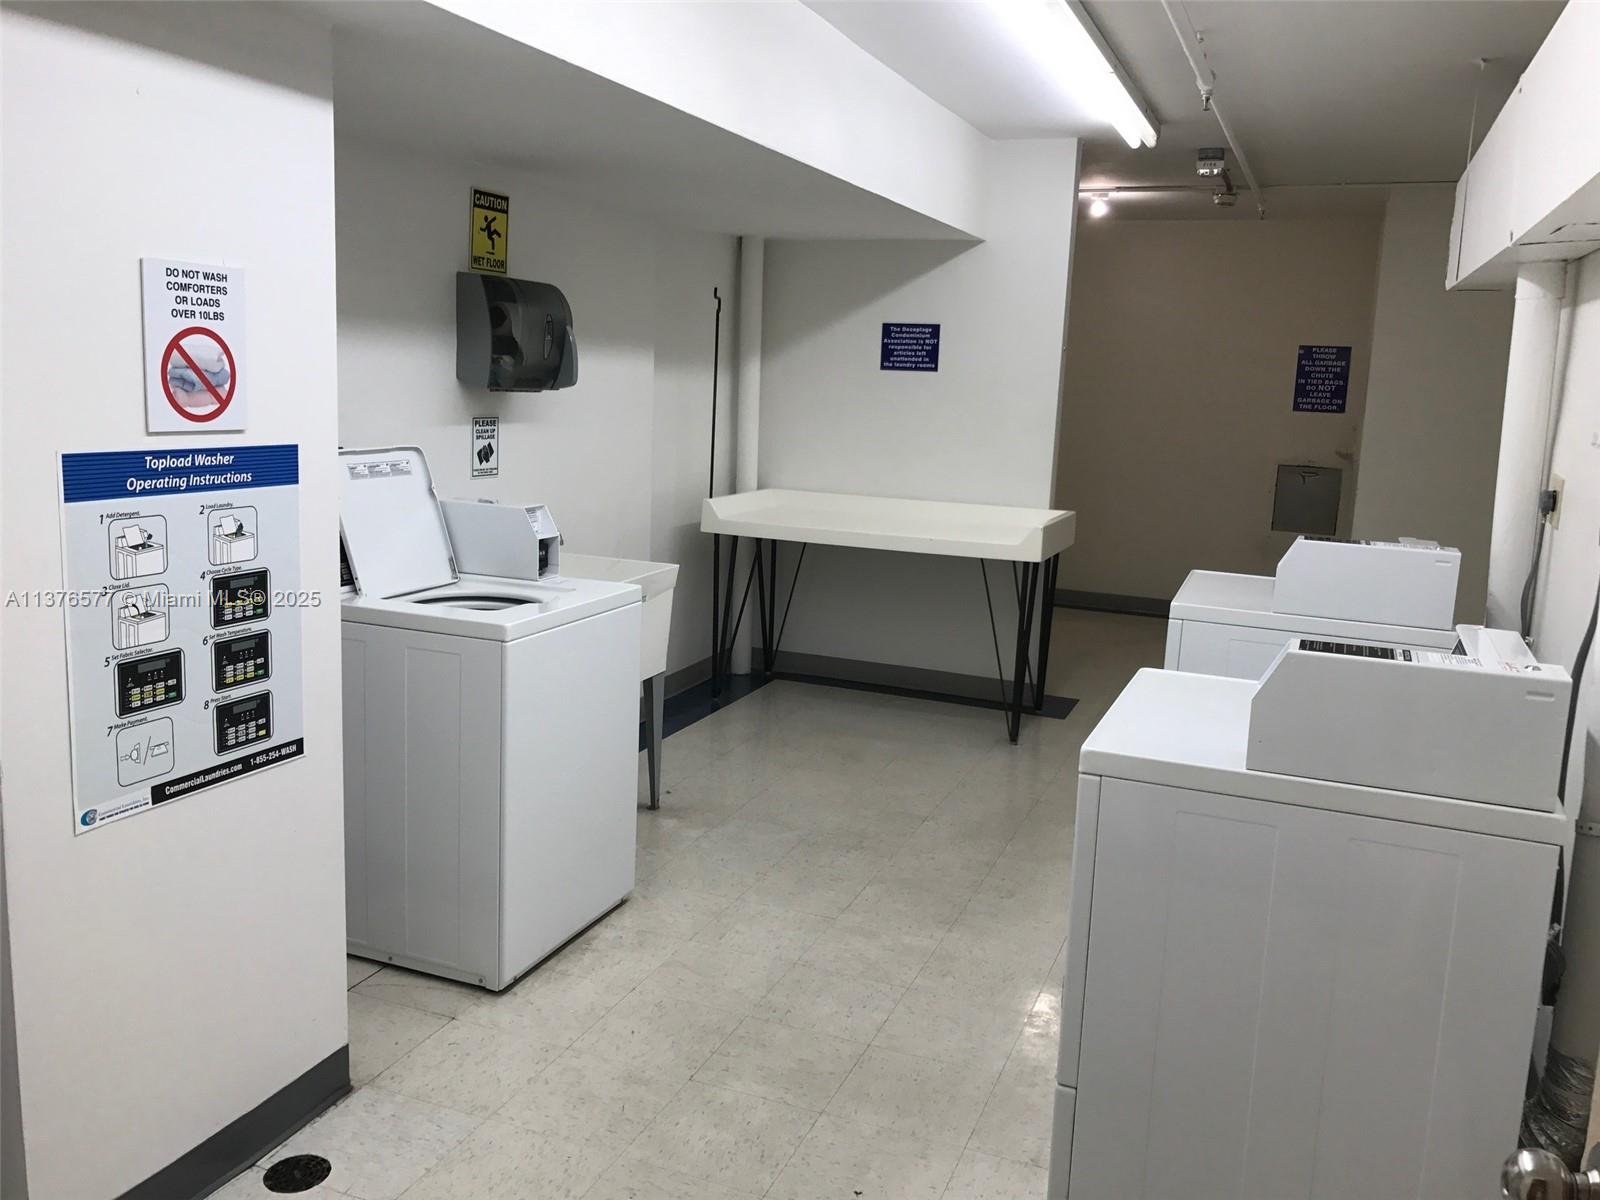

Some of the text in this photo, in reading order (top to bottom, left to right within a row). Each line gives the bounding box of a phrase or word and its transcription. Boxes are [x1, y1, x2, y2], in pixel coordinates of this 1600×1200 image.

[475, 194, 507, 210] CAUTION
[473, 256, 505, 269] WET FLOOR
[166, 267, 228, 282] DO NOT WASH
[166, 281, 228, 295] COMFORTERS
[174, 295, 220, 308] OR LOADS
[171, 308, 225, 321] OVER 10LBS
[144, 452, 235, 471] Topload Washer
[126, 471, 252, 493] Operating Instructions
[199, 504, 205, 515] 2
[99, 514, 104, 525] 1
[200, 570, 206, 581] 4
[101, 586, 109, 597] 3
[108, 582, 121, 591] Close
[202, 635, 209, 646] 6
[103, 656, 111, 668] 5
[111, 653, 119, 661] Set
[118, 651, 134, 660] Fabric
[203, 700, 210, 711] 8
[106, 726, 114, 737] 7
[113, 720, 127, 730] Make
[165, 744, 297, 795] CommercialLaundries.com 1-855-254-WASH
